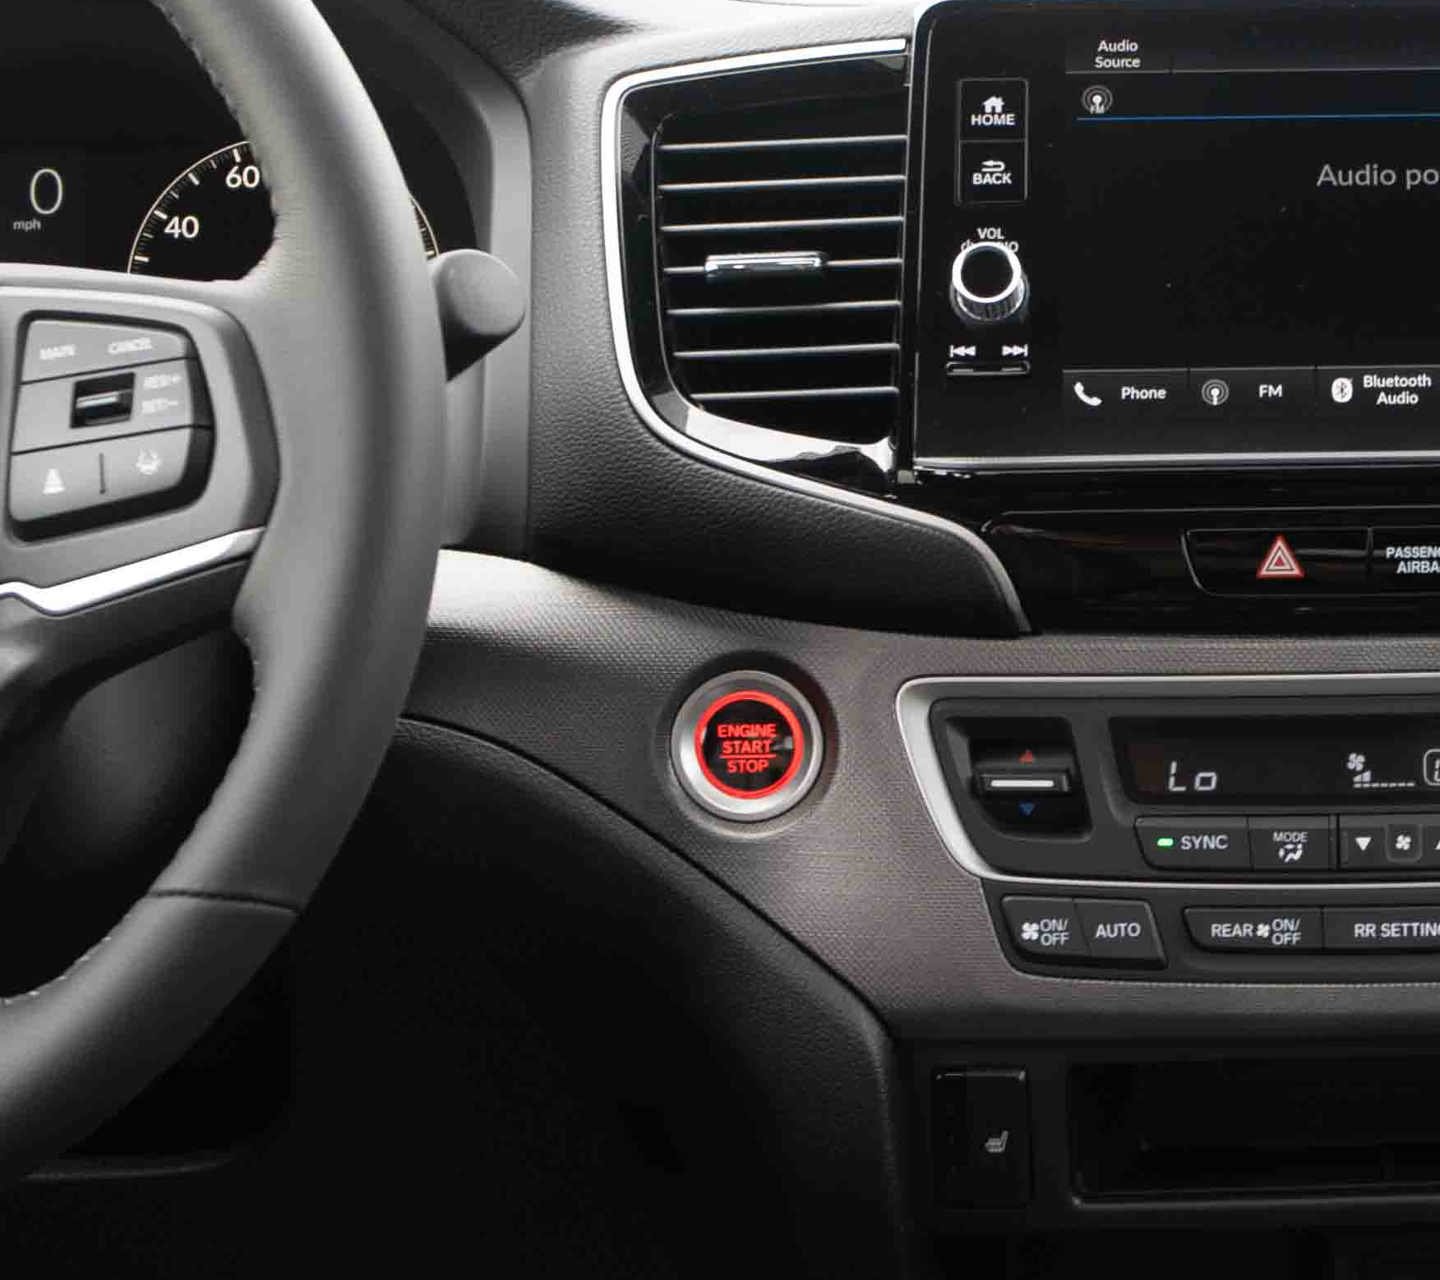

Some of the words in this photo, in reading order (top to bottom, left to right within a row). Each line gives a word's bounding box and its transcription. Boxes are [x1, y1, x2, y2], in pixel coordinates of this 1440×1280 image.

[1097, 39, 1139, 53] Audio
[1094, 55, 1141, 69] Source
[970, 113, 1016, 126] HOME
[225, 165, 261, 189] 60
[972, 172, 1013, 186] BACK
[1316, 163, 1397, 187] Audio
[28, 167, 64, 215] 0
[12, 218, 42, 233] mph
[164, 214, 201, 239] 40
[977, 227, 1005, 240] VOL
[1363, 374, 1432, 389] Bluetooth
[1120, 386, 1167, 401] Phone
[1258, 384, 1284, 399] FM
[1376, 391, 1419, 405] Audio
[716, 723, 777, 738] ENGINE
[722, 740, 773, 754] START
[727, 759, 769, 773] STOP
[1180, 834, 1229, 851] SYNC
[1272, 831, 1308, 843] MODE
[1039, 917, 1069, 932] ON/
[1095, 922, 1142, 938] AUTO
[1211, 923, 1254, 937] REAR
[1271, 917, 1301, 932] ON/
[1353, 923, 1378, 937] RR
[1041, 933, 1070, 946] OFF
[1271, 932, 1302, 945] OFF
